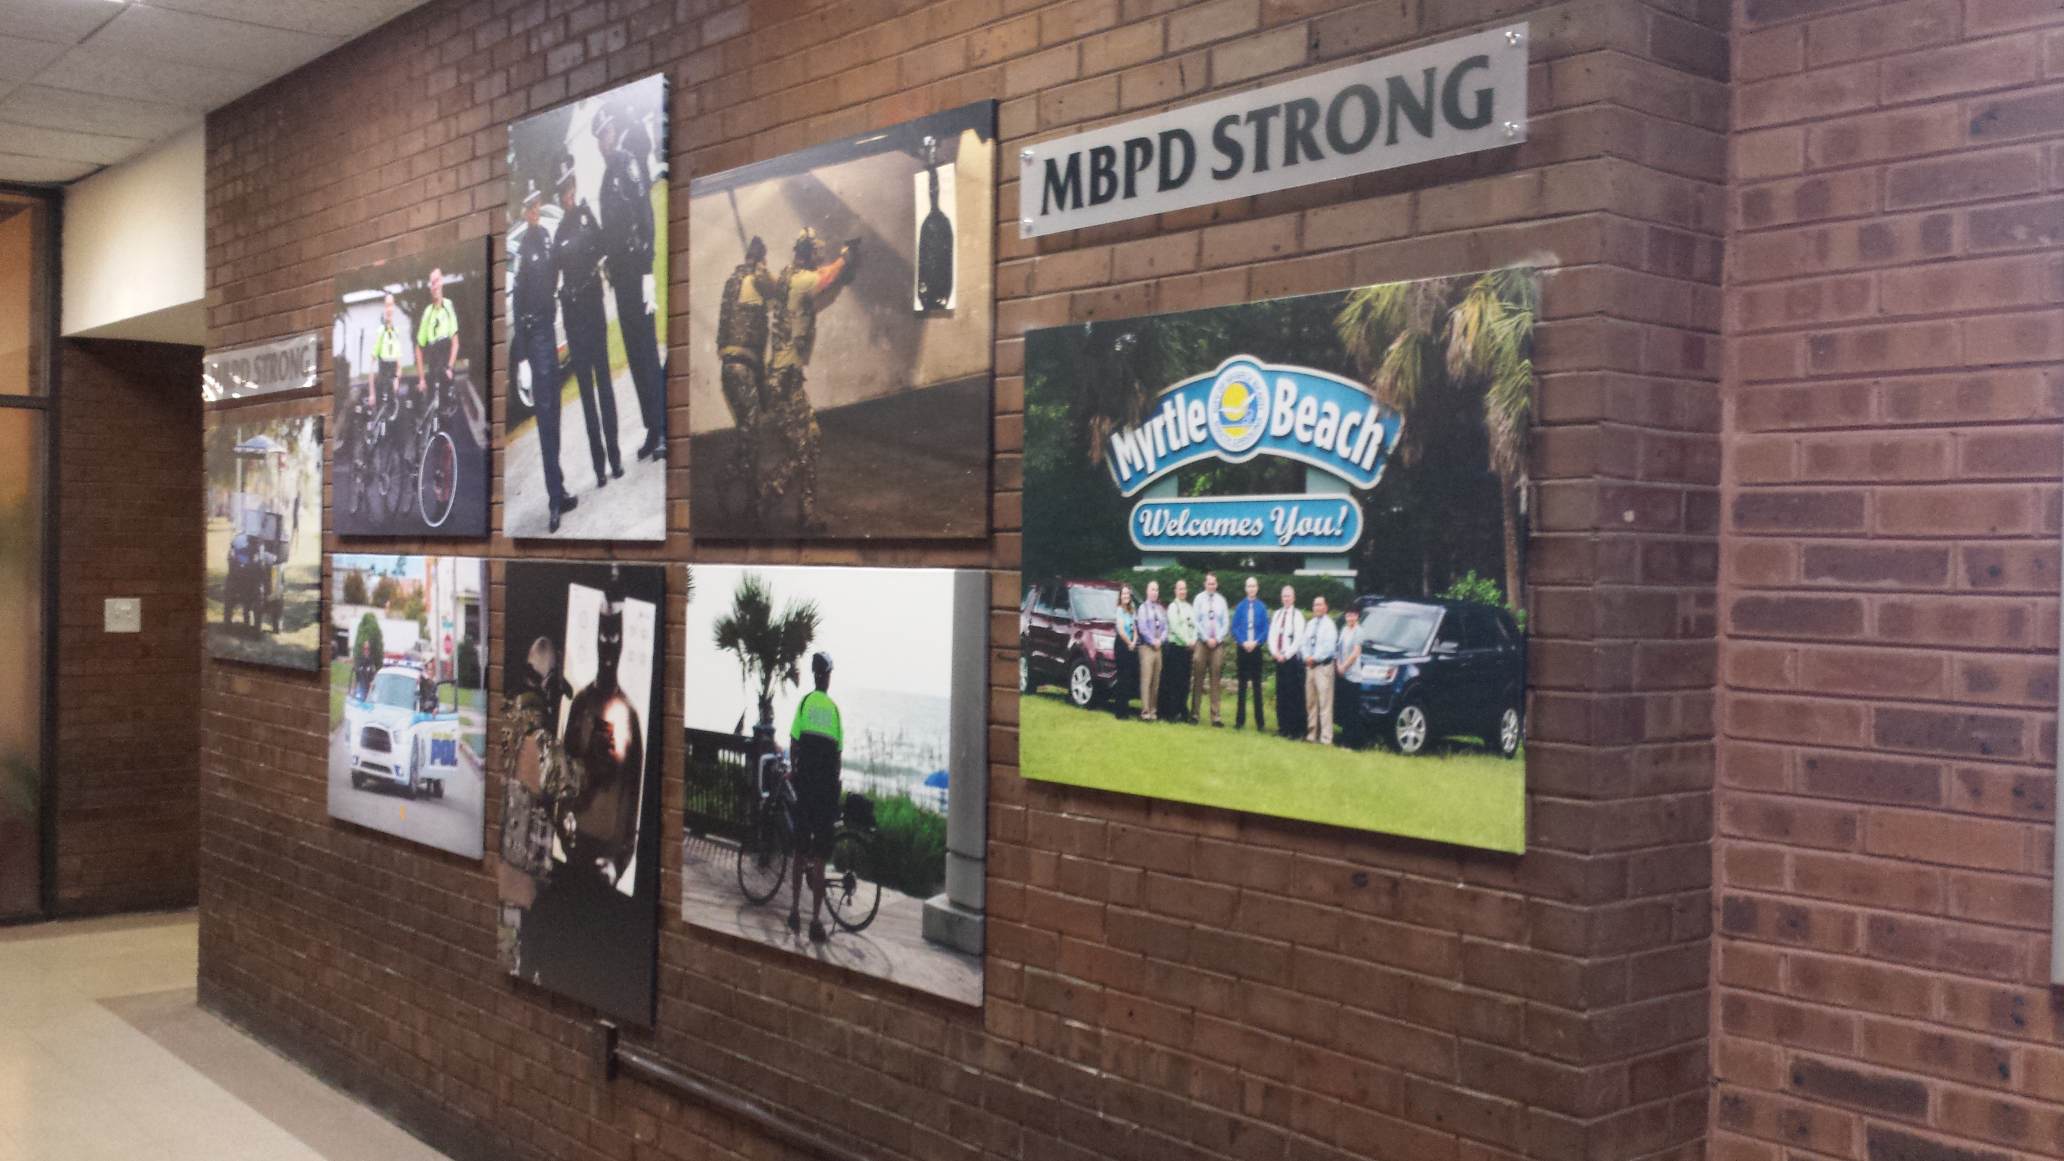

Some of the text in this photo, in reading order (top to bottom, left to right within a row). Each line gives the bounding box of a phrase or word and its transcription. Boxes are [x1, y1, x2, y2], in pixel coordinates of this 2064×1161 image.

[1040, 54, 1495, 215] MBPD STRONG
[253, 345, 310, 385] STRONG
[1110, 393, 1209, 482] Myrtle
[1270, 377, 1385, 472] Beach
[1138, 505, 1348, 547] Welcomes You!
